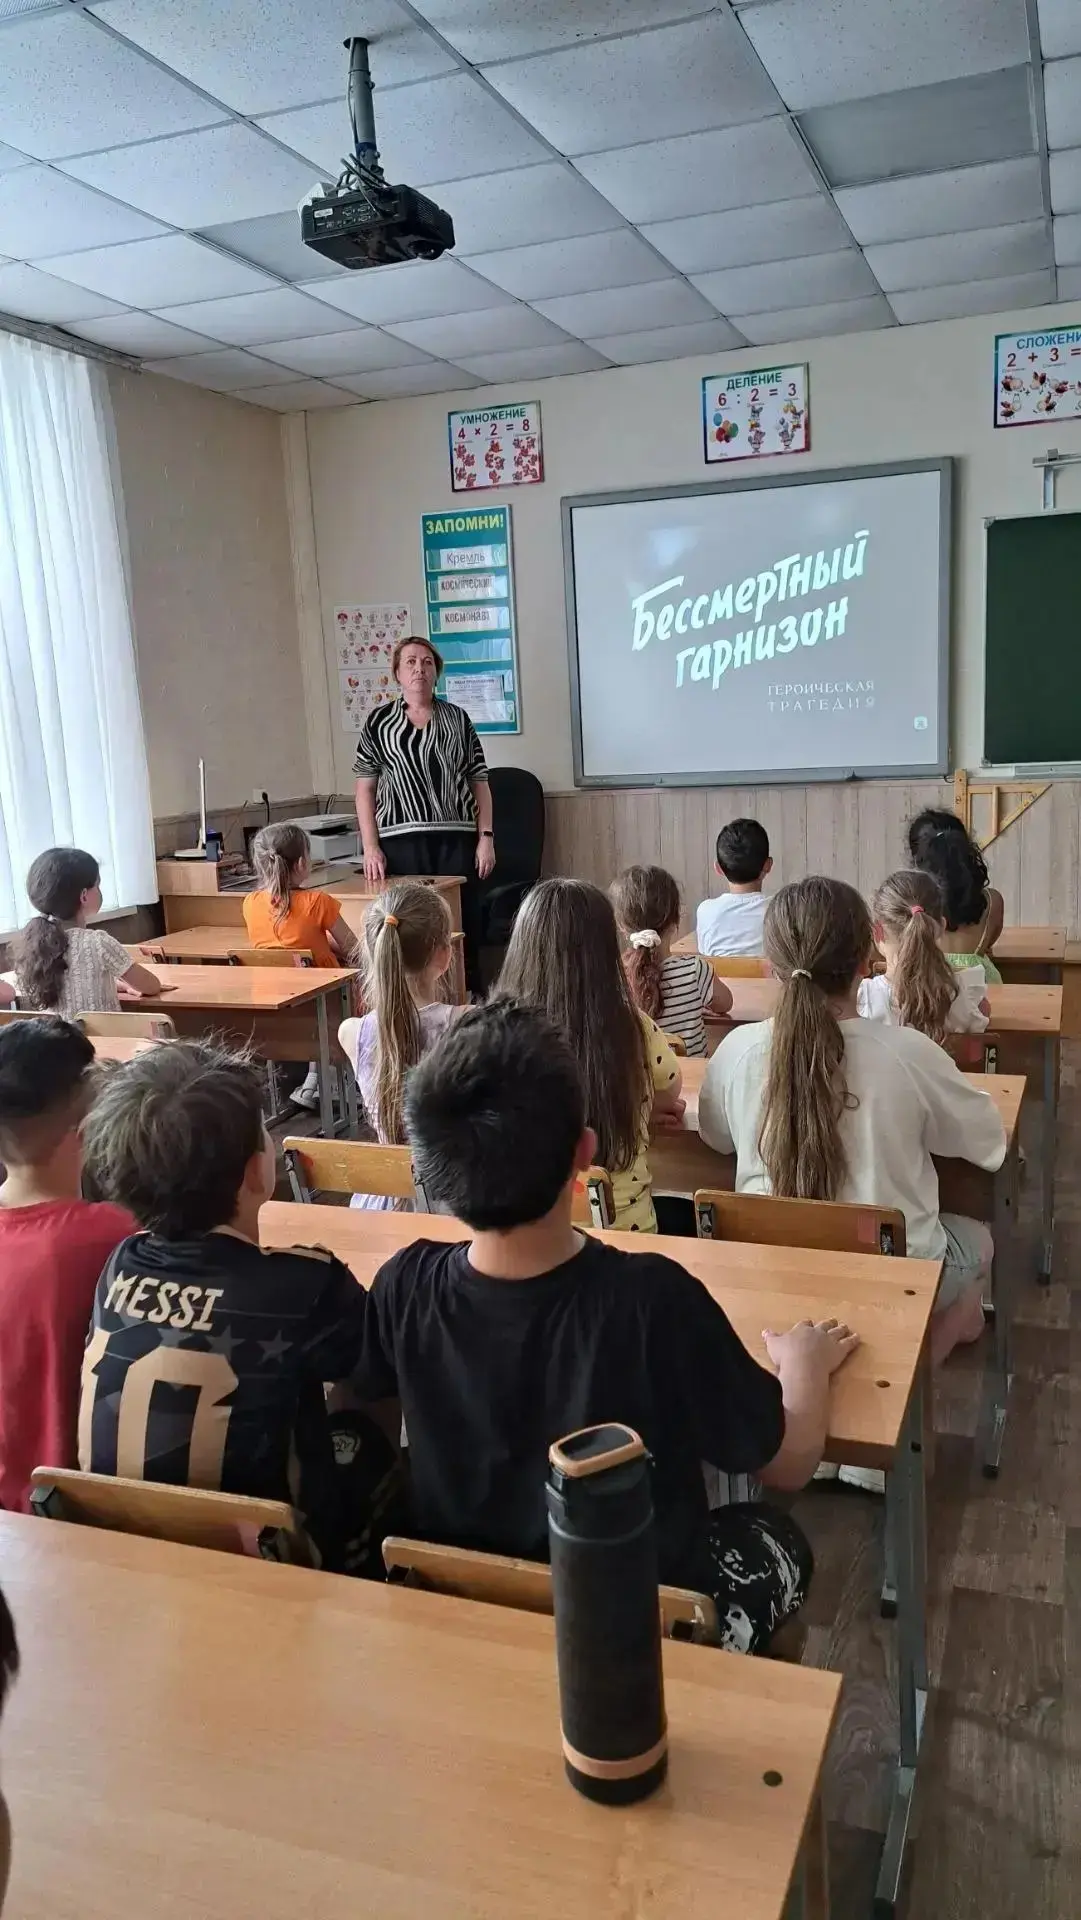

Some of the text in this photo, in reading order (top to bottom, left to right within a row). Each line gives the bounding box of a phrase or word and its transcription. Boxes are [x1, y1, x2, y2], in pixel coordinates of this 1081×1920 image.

[1007, 347, 1081, 367] 2 + 3 =
[726, 372, 782, 391] ДЕЛЕНИЕ
[718, 393, 727, 406] 6
[750, 388, 759, 402] 2
[769, 388, 778, 396] =
[788, 383, 797, 396] 3
[460, 407, 526, 425] УМНОЖЕНИЕ
[458, 427, 466, 440] 4
[490, 423, 498, 436] 2
[506, 423, 514, 431] =
[522, 419, 530, 432] 8
[426, 514, 504, 535] ЗАПОМНИ!
[446, 551, 485, 566] Кремль
[631, 529, 870, 651] Бессмертный
[675, 596, 849, 690] гарнизон
[768, 680, 875, 696] ГЕРОИЧЕСКАЯ
[767, 696, 875, 712] ТРАГЕДИЯ
[103, 1270, 225, 1331] MESSI
[77, 1326, 240, 1491] 10
